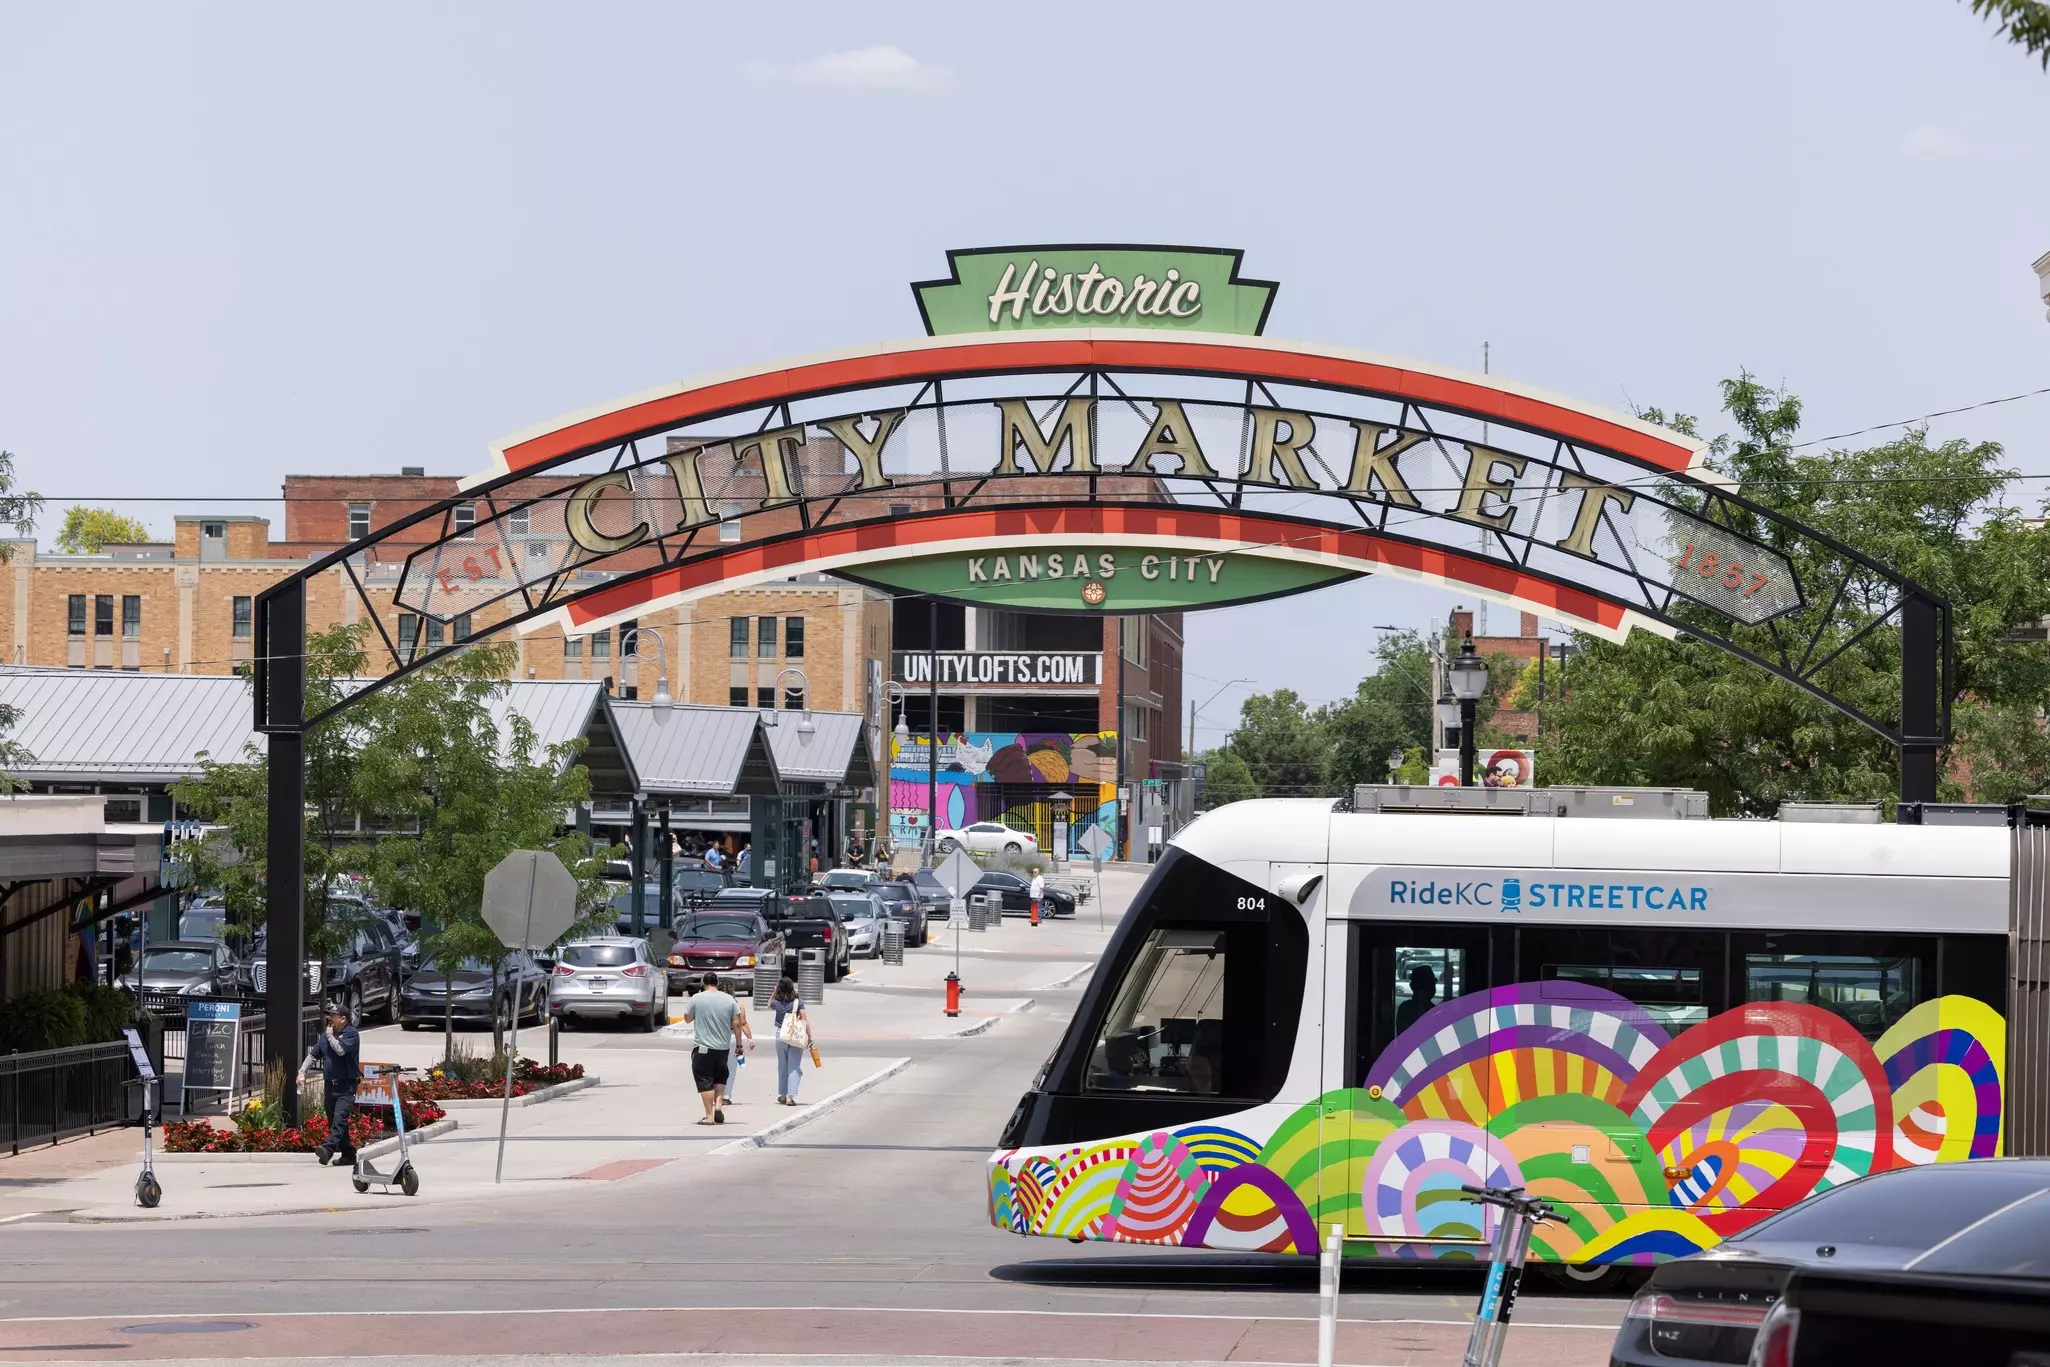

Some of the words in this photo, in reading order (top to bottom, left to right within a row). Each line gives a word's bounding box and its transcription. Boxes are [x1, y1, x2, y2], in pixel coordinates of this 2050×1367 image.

[988, 259, 1201, 323] Historic
[565, 408, 906, 553] CITY
[993, 397, 1636, 560] MARKET
[436, 545, 503, 593] EST
[968, 553, 1115, 582] KANSAS
[1141, 554, 1225, 583] CITY
[1678, 543, 1768, 597] 1857
[904, 655, 1084, 682] UNITYLOFTS.COM
[1237, 897, 1265, 910] 804
[1390, 880, 1493, 906] RideKC
[1529, 884, 1708, 911] STREETCAR
[198, 1003, 231, 1013] PERONI
[191, 1021, 233, 1035] ENZO
[1697, 1291, 1775, 1303] LINC
